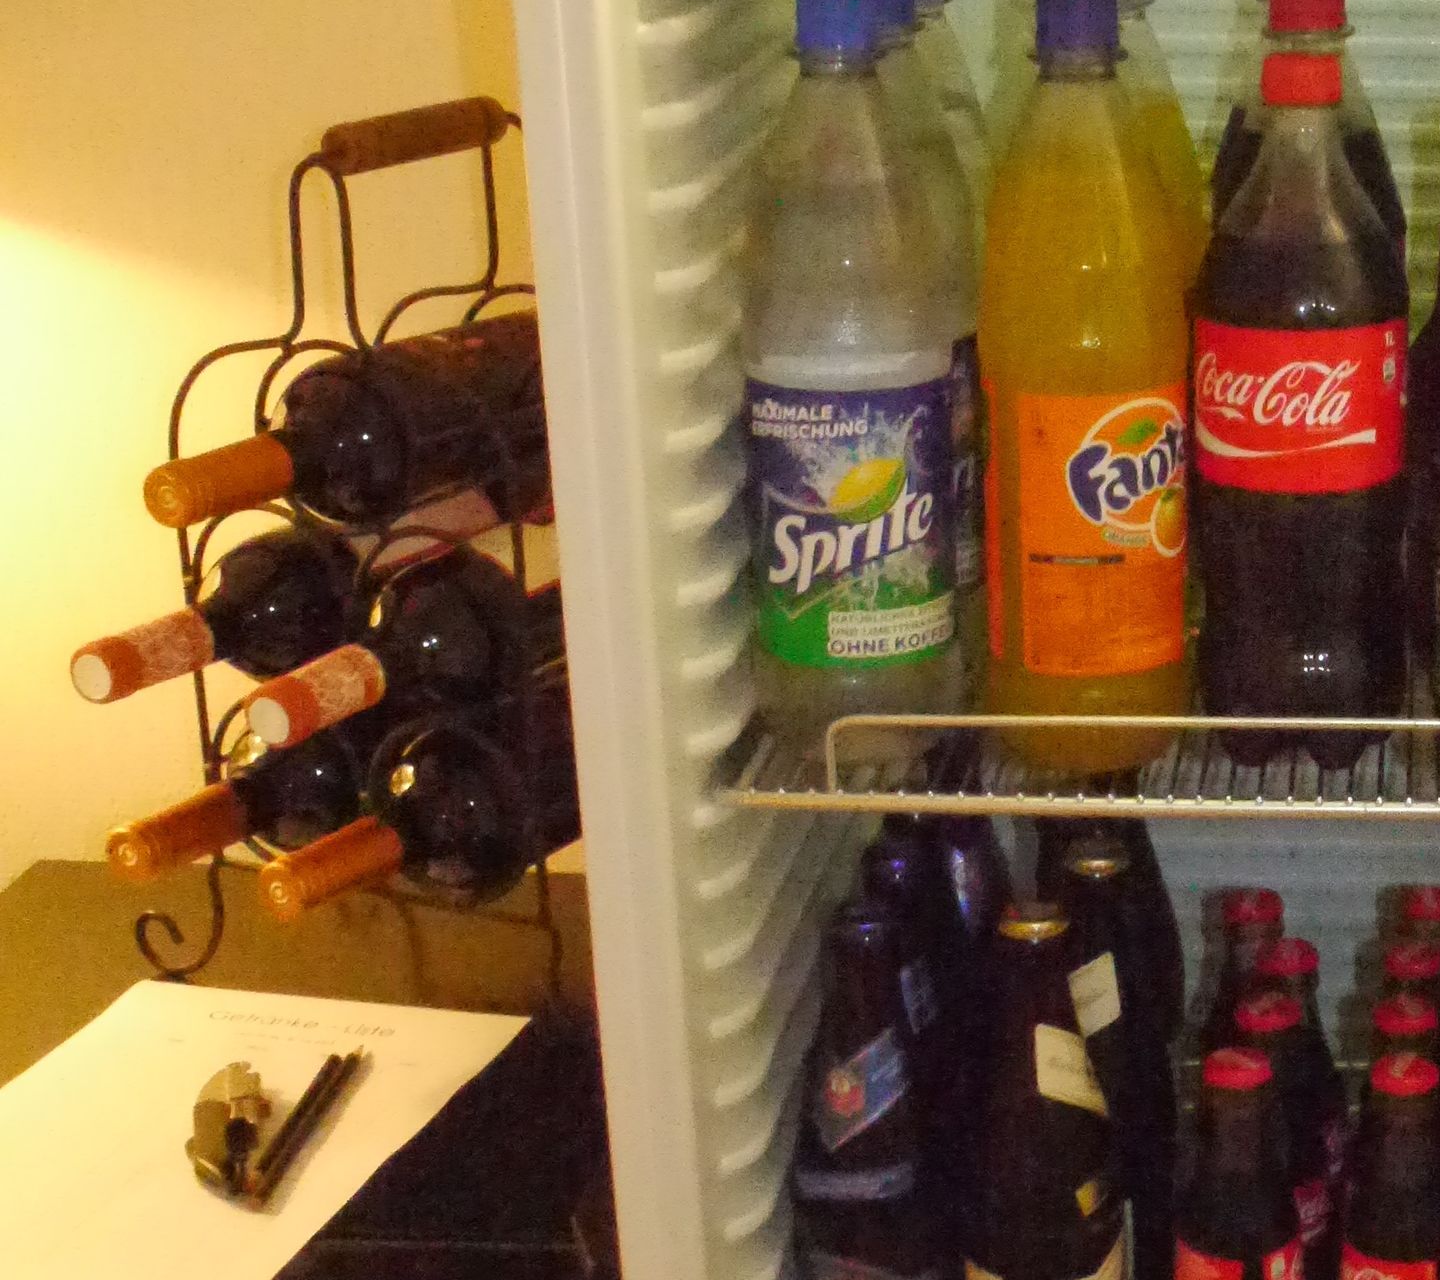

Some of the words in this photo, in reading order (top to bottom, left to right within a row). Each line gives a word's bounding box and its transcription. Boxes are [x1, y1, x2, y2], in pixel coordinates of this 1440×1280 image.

[1199, 353, 1361, 427] Coca-Cola
[1066, 421, 1185, 525] Fant
[768, 480, 933, 593] Sprite
[830, 638, 889, 655] OHNE
